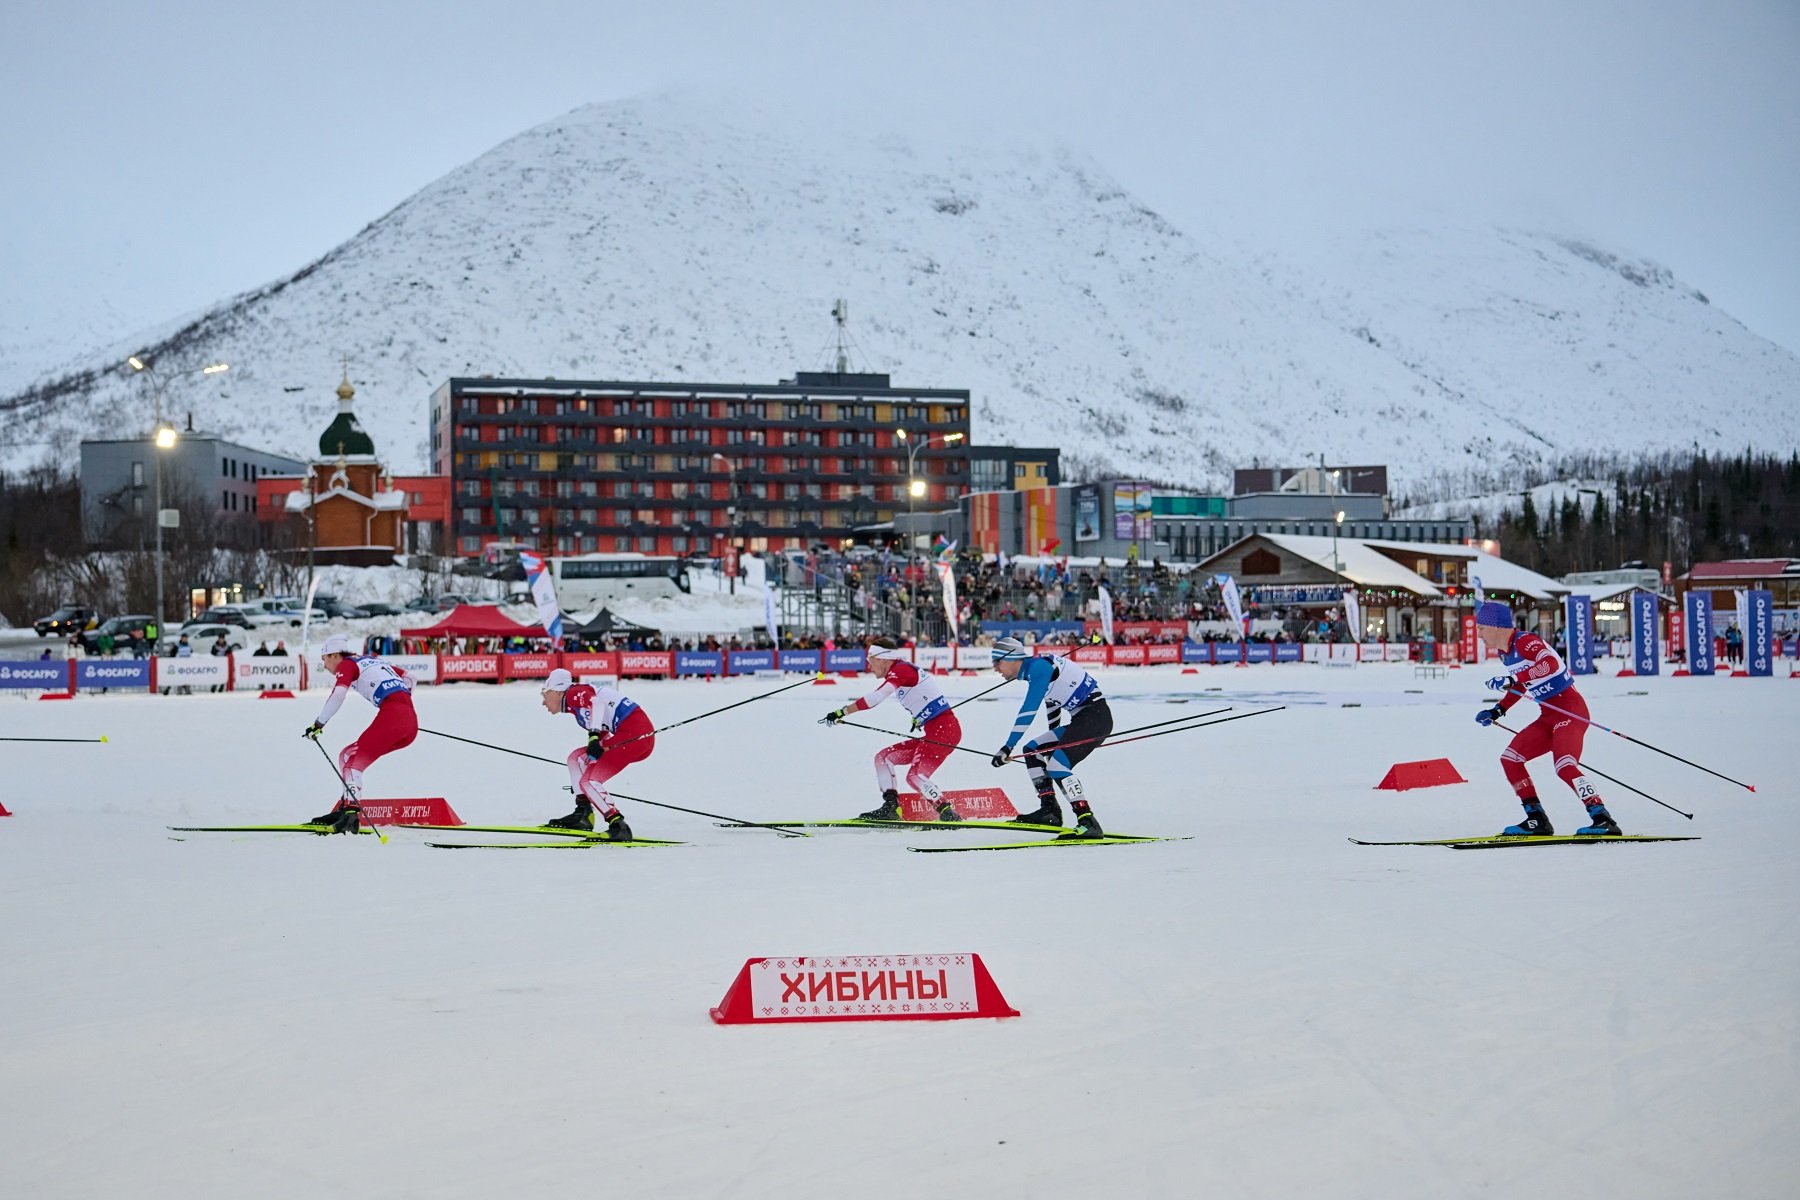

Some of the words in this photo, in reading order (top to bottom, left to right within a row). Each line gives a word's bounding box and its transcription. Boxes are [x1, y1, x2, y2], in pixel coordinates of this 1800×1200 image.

[1575, 602, 1585, 655] ФОСАГРО
[1643, 601, 1652, 656] ФОСАГРО
[1696, 599, 1706, 655] ФОСАГРО
[1756, 599, 1765, 656] ФОСАГРО
[443, 661, 497, 672] КИРОВСК
[514, 661, 548, 669] КИРОВСК
[573, 660, 608, 669] КИРОВСК
[623, 657, 670, 668] КИРОВСК
[12, 670, 59, 679] ФОСАГРО
[97, 668, 141, 677] ФОСАГРО
[252, 664, 295, 675] ЛУКОЙЛ
[929, 788, 938, 799] 5
[1069, 784, 1082, 797] 15
[1579, 784, 1595, 798] 26
[362, 806, 393, 818] СЕВЕРЕ
[401, 806, 431, 818] ЖИТЬ!
[781, 969, 948, 1003] ХИБИНЫ
